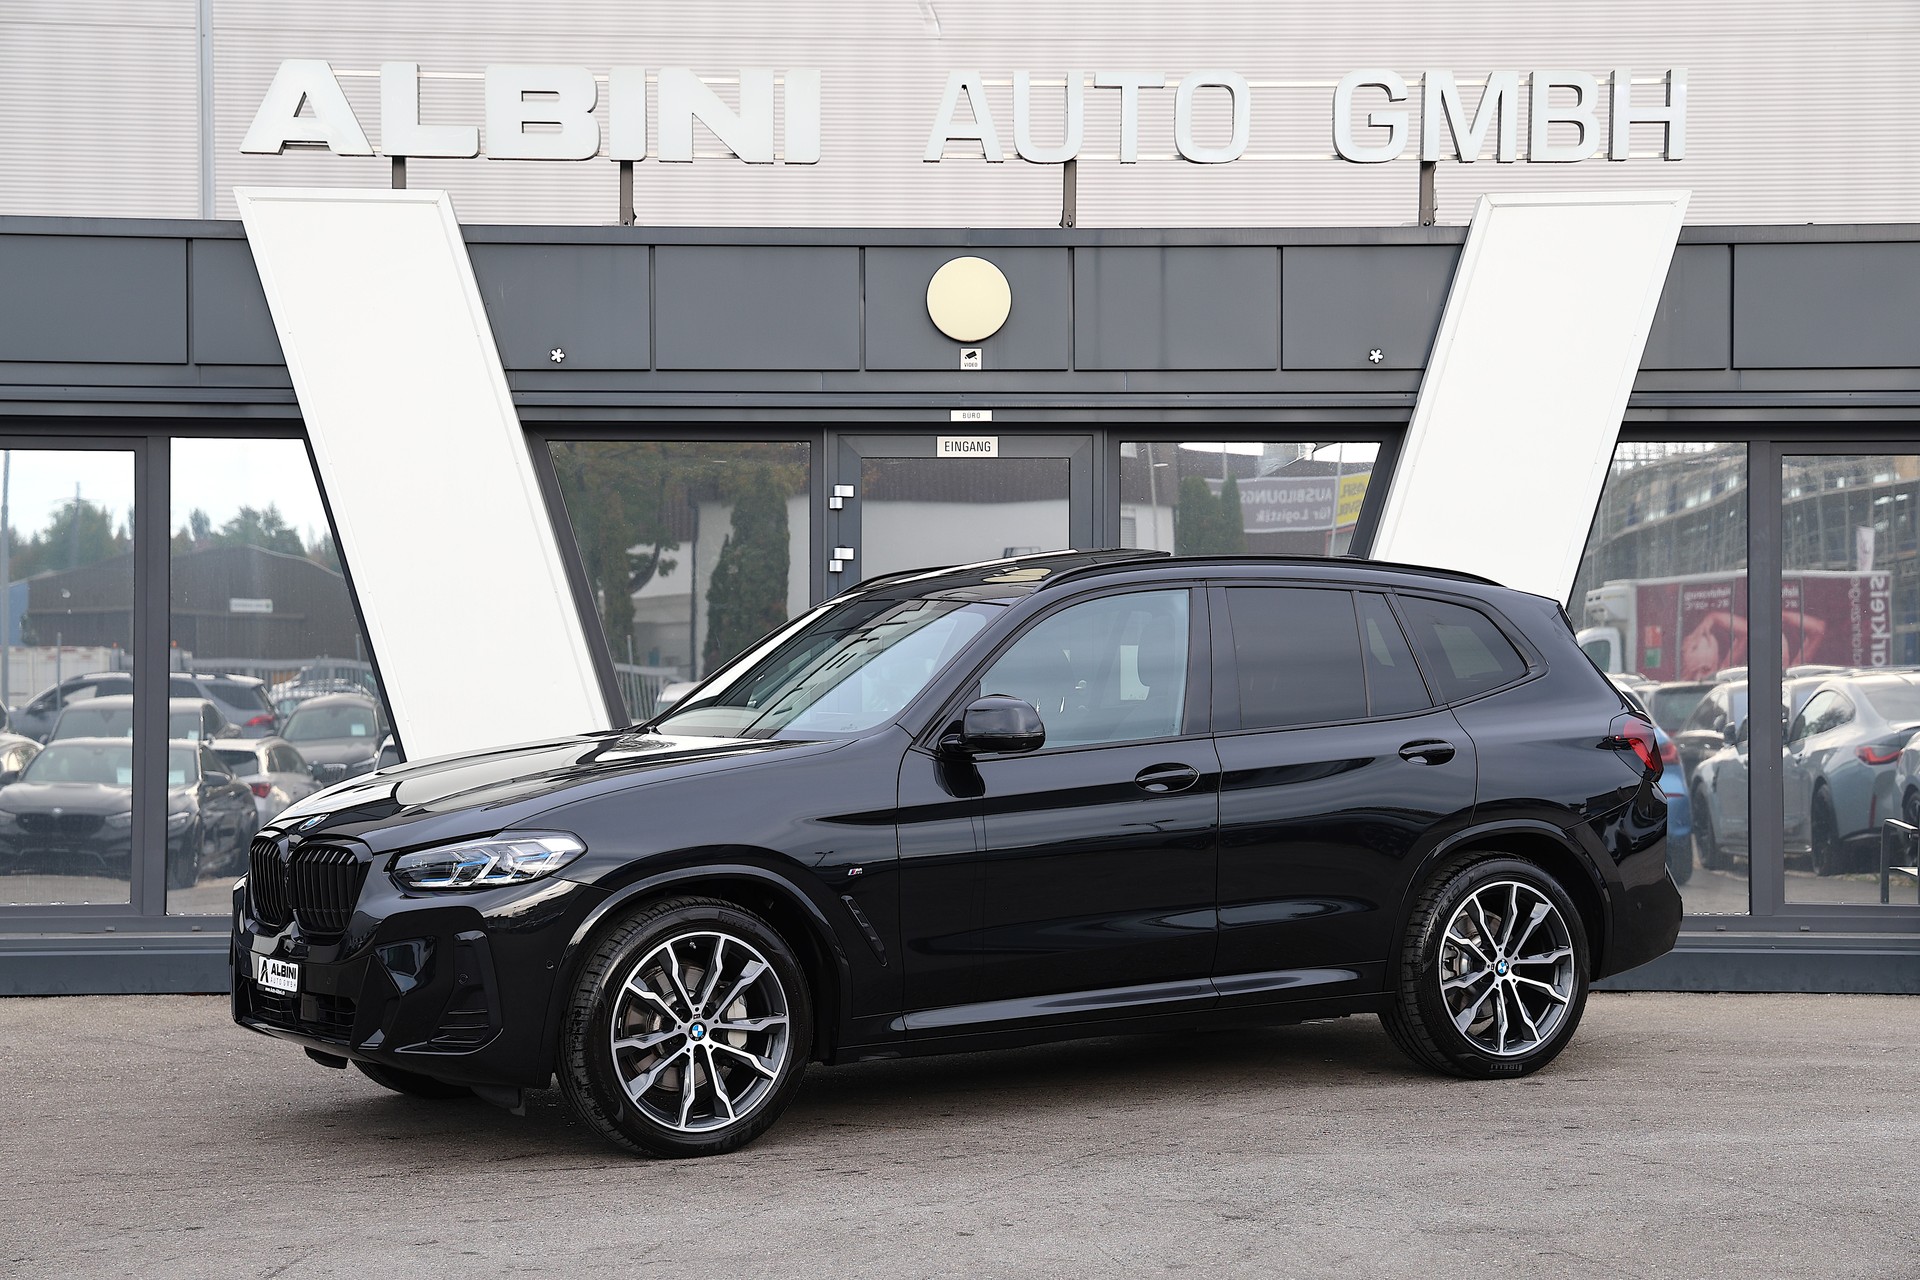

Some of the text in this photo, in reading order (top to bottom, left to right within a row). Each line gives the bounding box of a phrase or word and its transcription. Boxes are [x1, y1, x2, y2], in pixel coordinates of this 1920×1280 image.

[239, 59, 1688, 165] ALBINI AUTO GMBH
[944, 440, 991, 452] EINGANG
[271, 963, 297, 980] ALBINI
